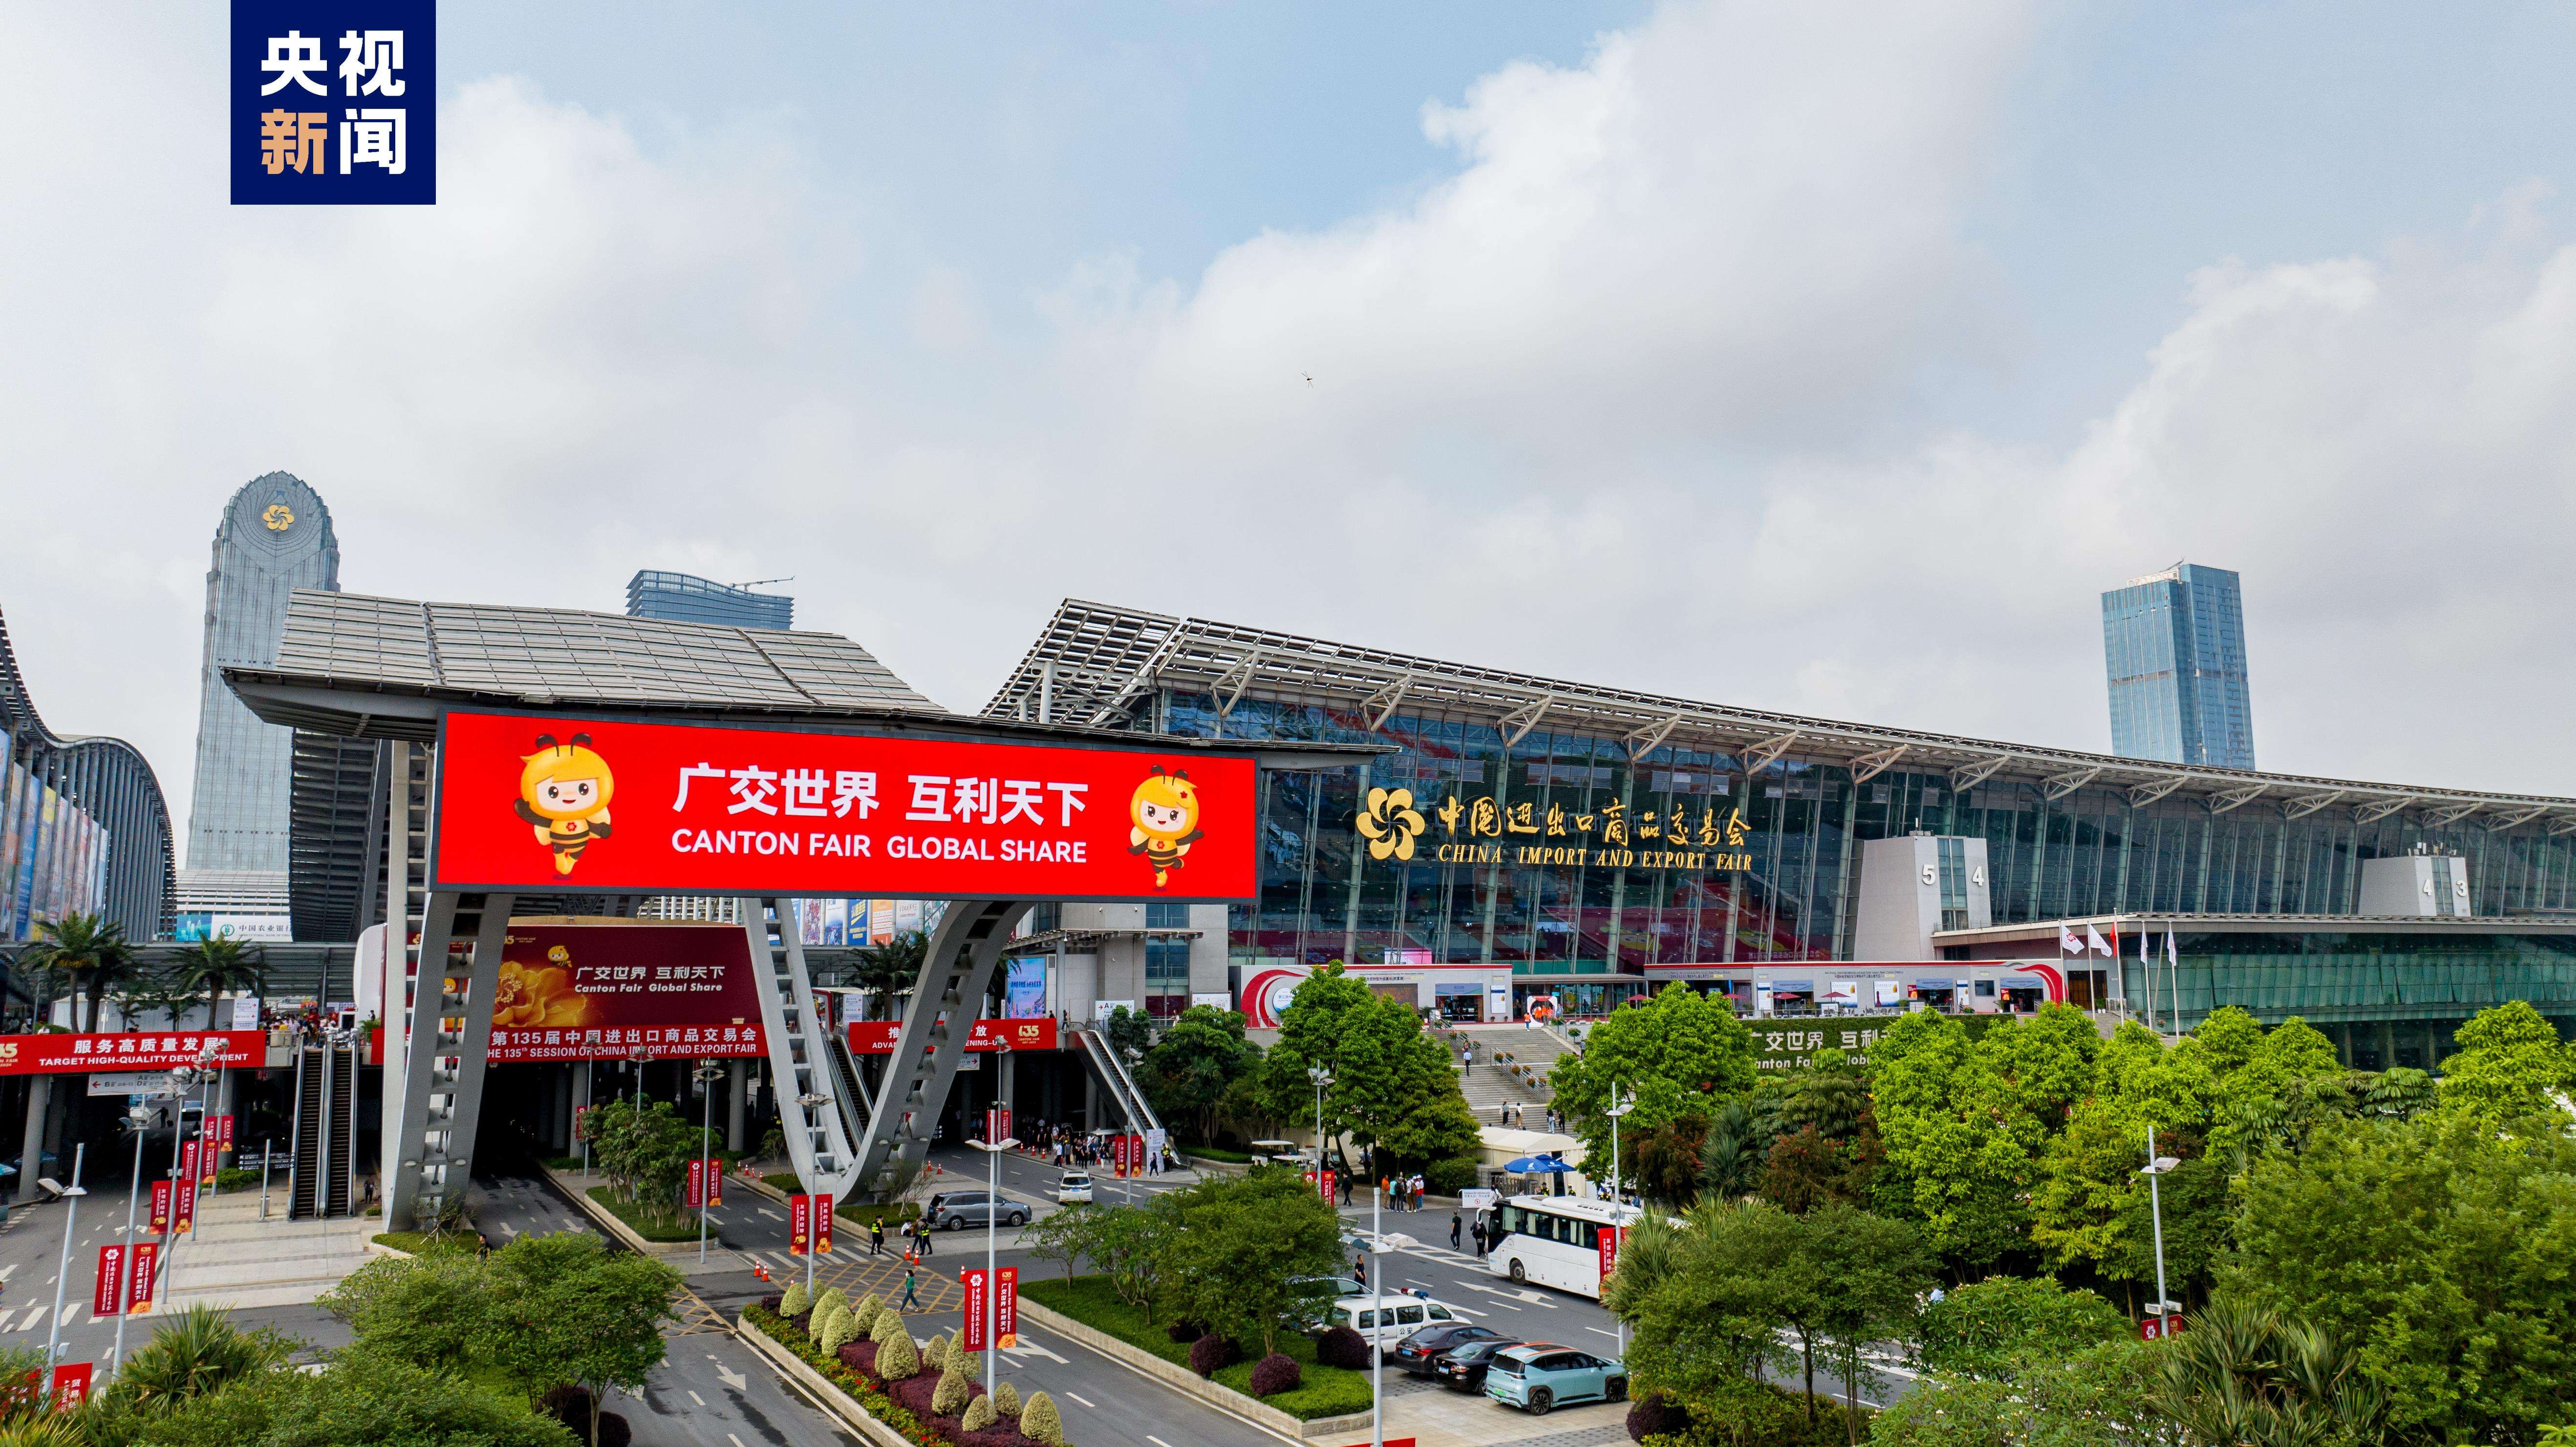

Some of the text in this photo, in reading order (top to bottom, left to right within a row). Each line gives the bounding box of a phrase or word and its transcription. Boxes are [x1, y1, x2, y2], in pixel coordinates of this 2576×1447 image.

[672, 763, 1089, 827] 广交世界 互利天下
[672, 829, 1087, 863] CANTON FAIR GLOBAL SHARE
[1438, 844, 1753, 871] CHINA IMPORT AND EXPORT FAIR
[1922, 864, 1935, 885] 5
[1972, 866, 1984, 886] 4
[2423, 879, 2432, 896] 4
[2456, 880, 2468, 896] 3
[576, 966, 725, 980] 广交世界 互利天下
[575, 983, 722, 993] Canton Fair Global Share
[74, 1037, 220, 1054] 服务高质量发展
[487, 1049, 501, 1058] HE
[530, 1047, 576, 1057] SESSION
[595, 1046, 626, 1056] CHINA
[670, 1044, 691, 1054] AND
[694, 1044, 732, 1053] EXPORT
[735, 1043, 756, 1053] FAIR
[39, 1058, 86, 1066] TARGET
[87, 1055, 167, 1064] HIGH-QUALITY
[1757, 1058, 1790, 1069] anton
